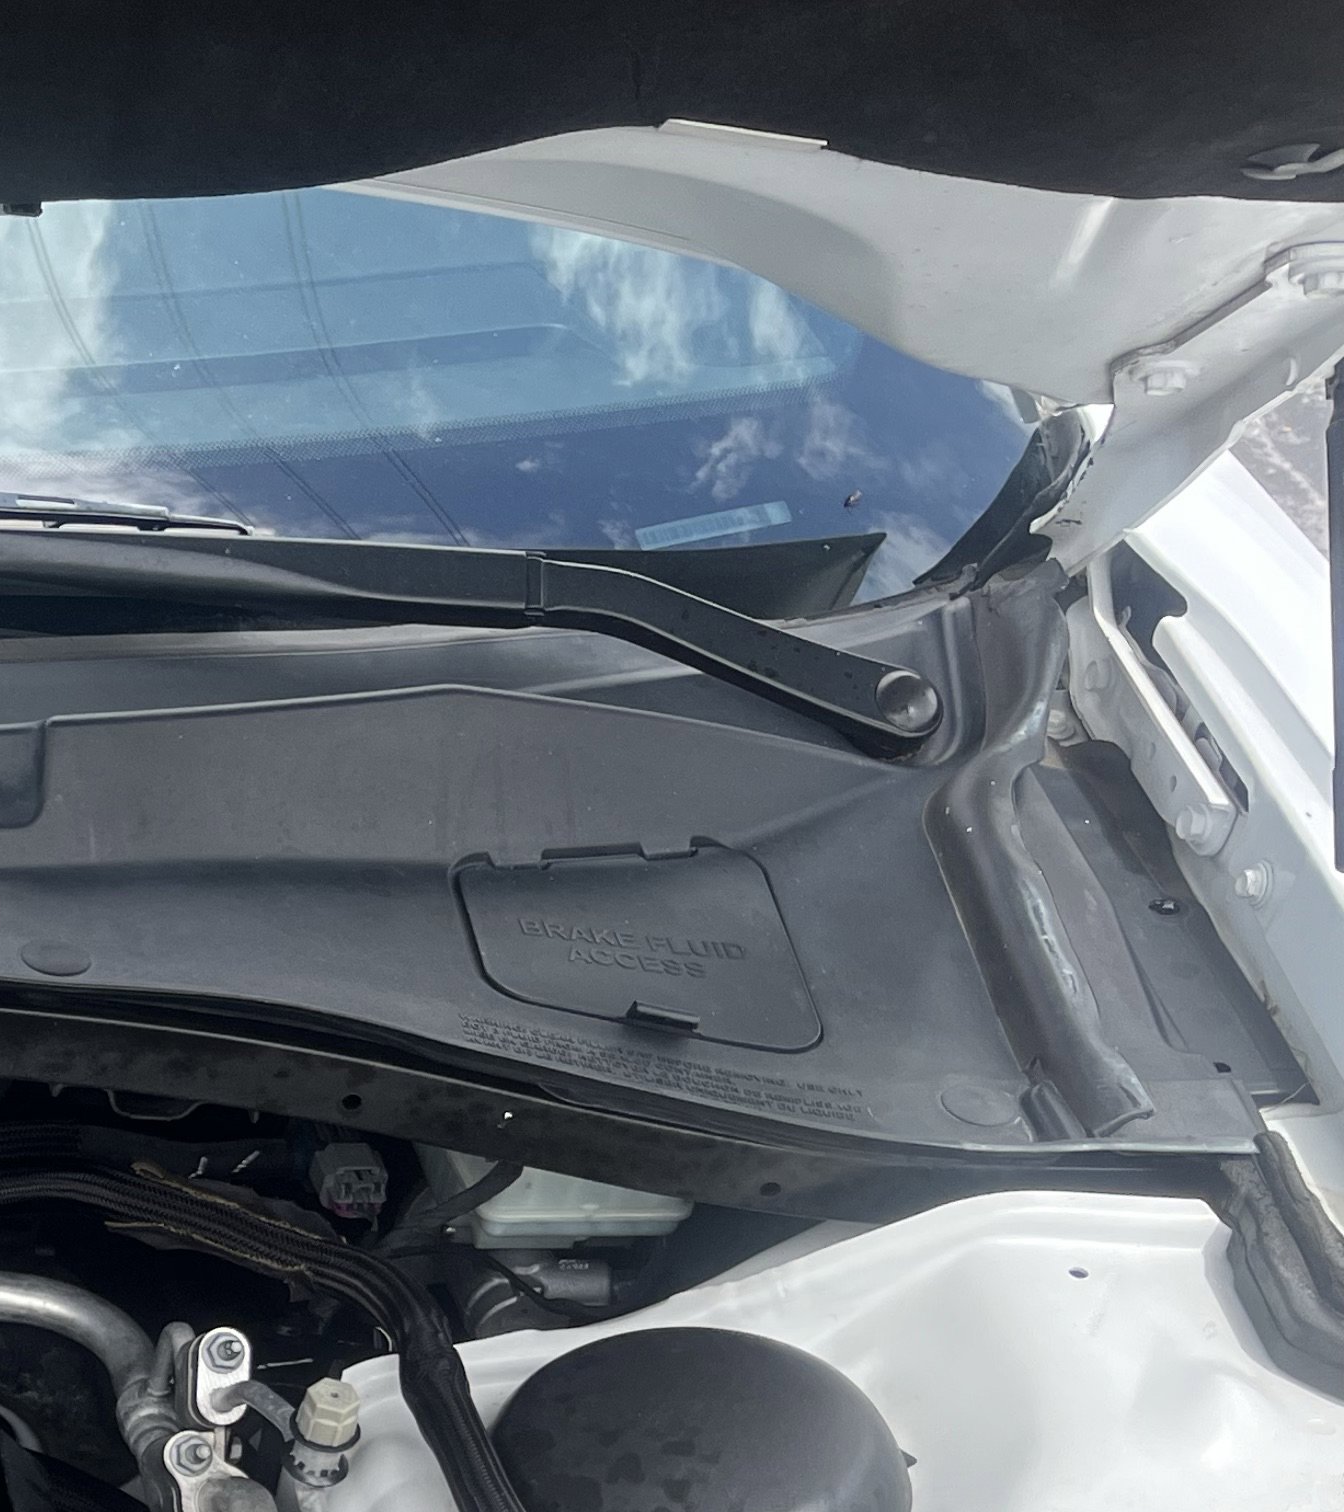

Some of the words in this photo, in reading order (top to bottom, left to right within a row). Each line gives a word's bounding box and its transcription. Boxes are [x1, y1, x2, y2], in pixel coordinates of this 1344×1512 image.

[519, 917, 636, 950] BRAKE
[645, 935, 747, 962] FLUID
[568, 945, 707, 979] ACCESS
